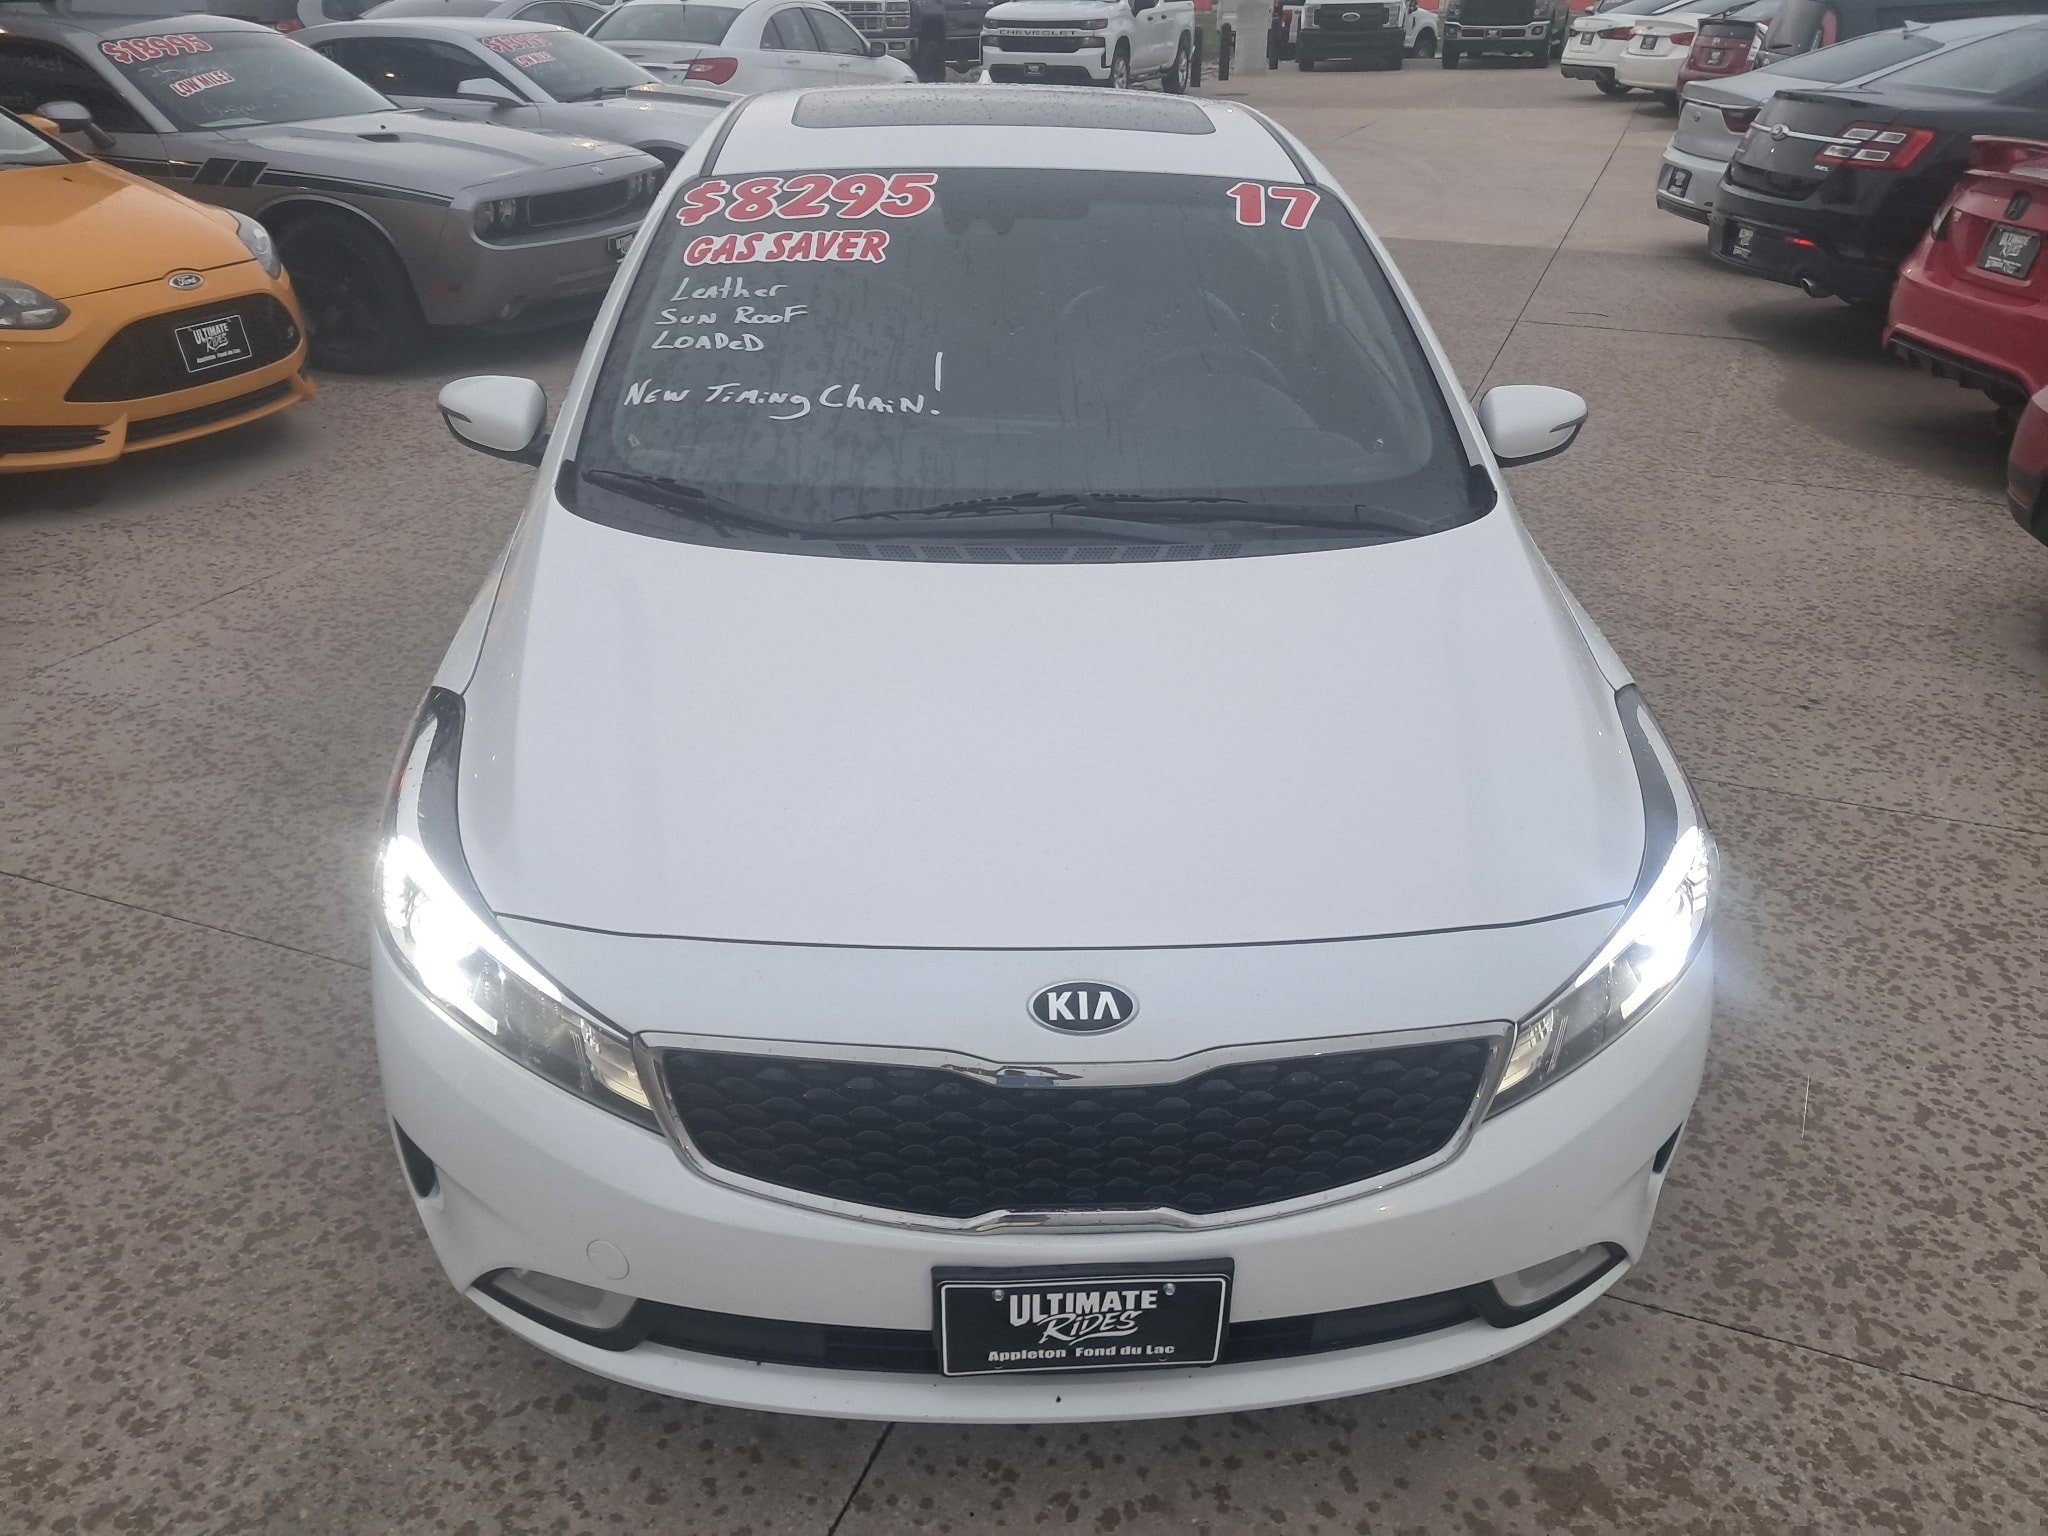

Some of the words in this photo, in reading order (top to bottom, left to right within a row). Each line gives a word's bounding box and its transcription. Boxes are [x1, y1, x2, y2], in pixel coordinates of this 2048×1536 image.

[102, 33, 213, 64] $18995
[169, 77, 202, 97] LOW
[195, 69, 235, 90] MILES
[676, 173, 938, 226] $8295
[1226, 182, 1321, 229] 17
[684, 232, 764, 266] GAS
[763, 230, 889, 263] SAVER
[177, 275, 197, 286] Ford
[193, 323, 229, 345] ULTIMATE
[1047, 991, 1121, 1020] KIA
[1009, 1290, 1158, 1327] ULTIMATE
[987, 1349, 1066, 1362] Appleton
[1075, 1346, 1115, 1357] Fond
[1120, 1345, 1142, 1355] du
[1146, 1345, 1175, 1355] Lac
